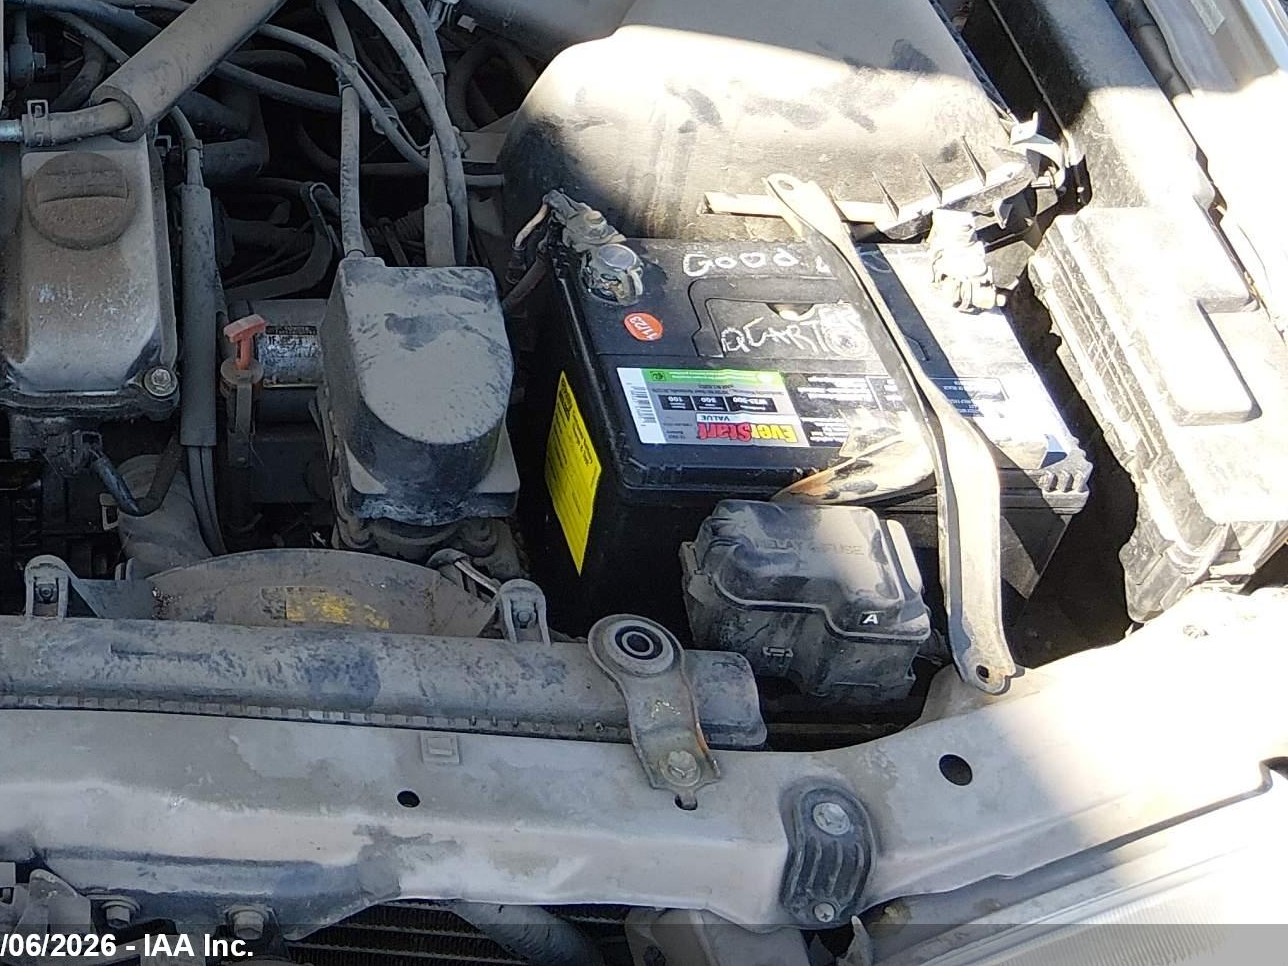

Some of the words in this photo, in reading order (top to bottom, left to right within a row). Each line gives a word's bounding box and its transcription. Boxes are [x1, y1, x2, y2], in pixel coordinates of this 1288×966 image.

[629, 315, 659, 340] 11/23
[700, 414, 730, 422] VALUE
[862, 614, 879, 625] A
